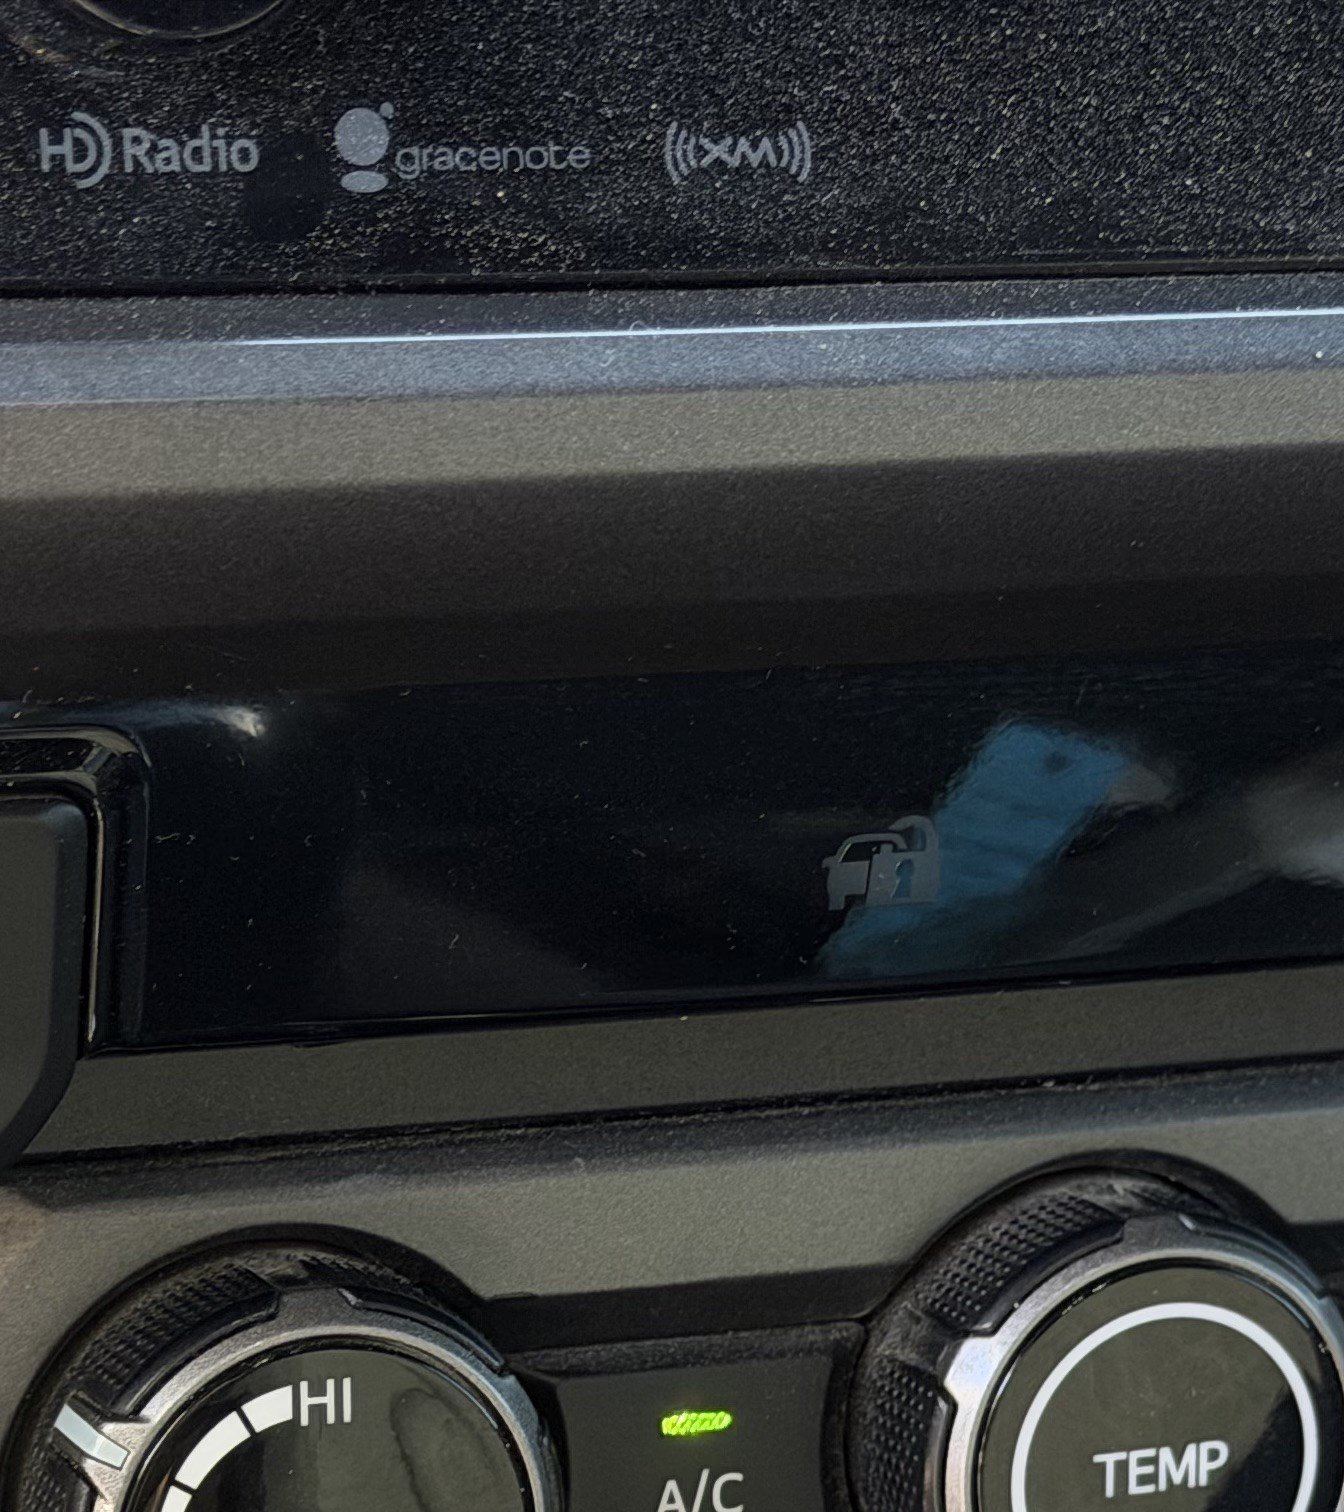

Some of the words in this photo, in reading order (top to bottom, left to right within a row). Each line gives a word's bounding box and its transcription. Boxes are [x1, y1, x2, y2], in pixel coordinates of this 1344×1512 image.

[121, 124, 259, 174] Radio
[395, 140, 593, 181] gracenote
[299, 1376, 353, 1427] HI
[1092, 1439, 1229, 1499] TEMP
